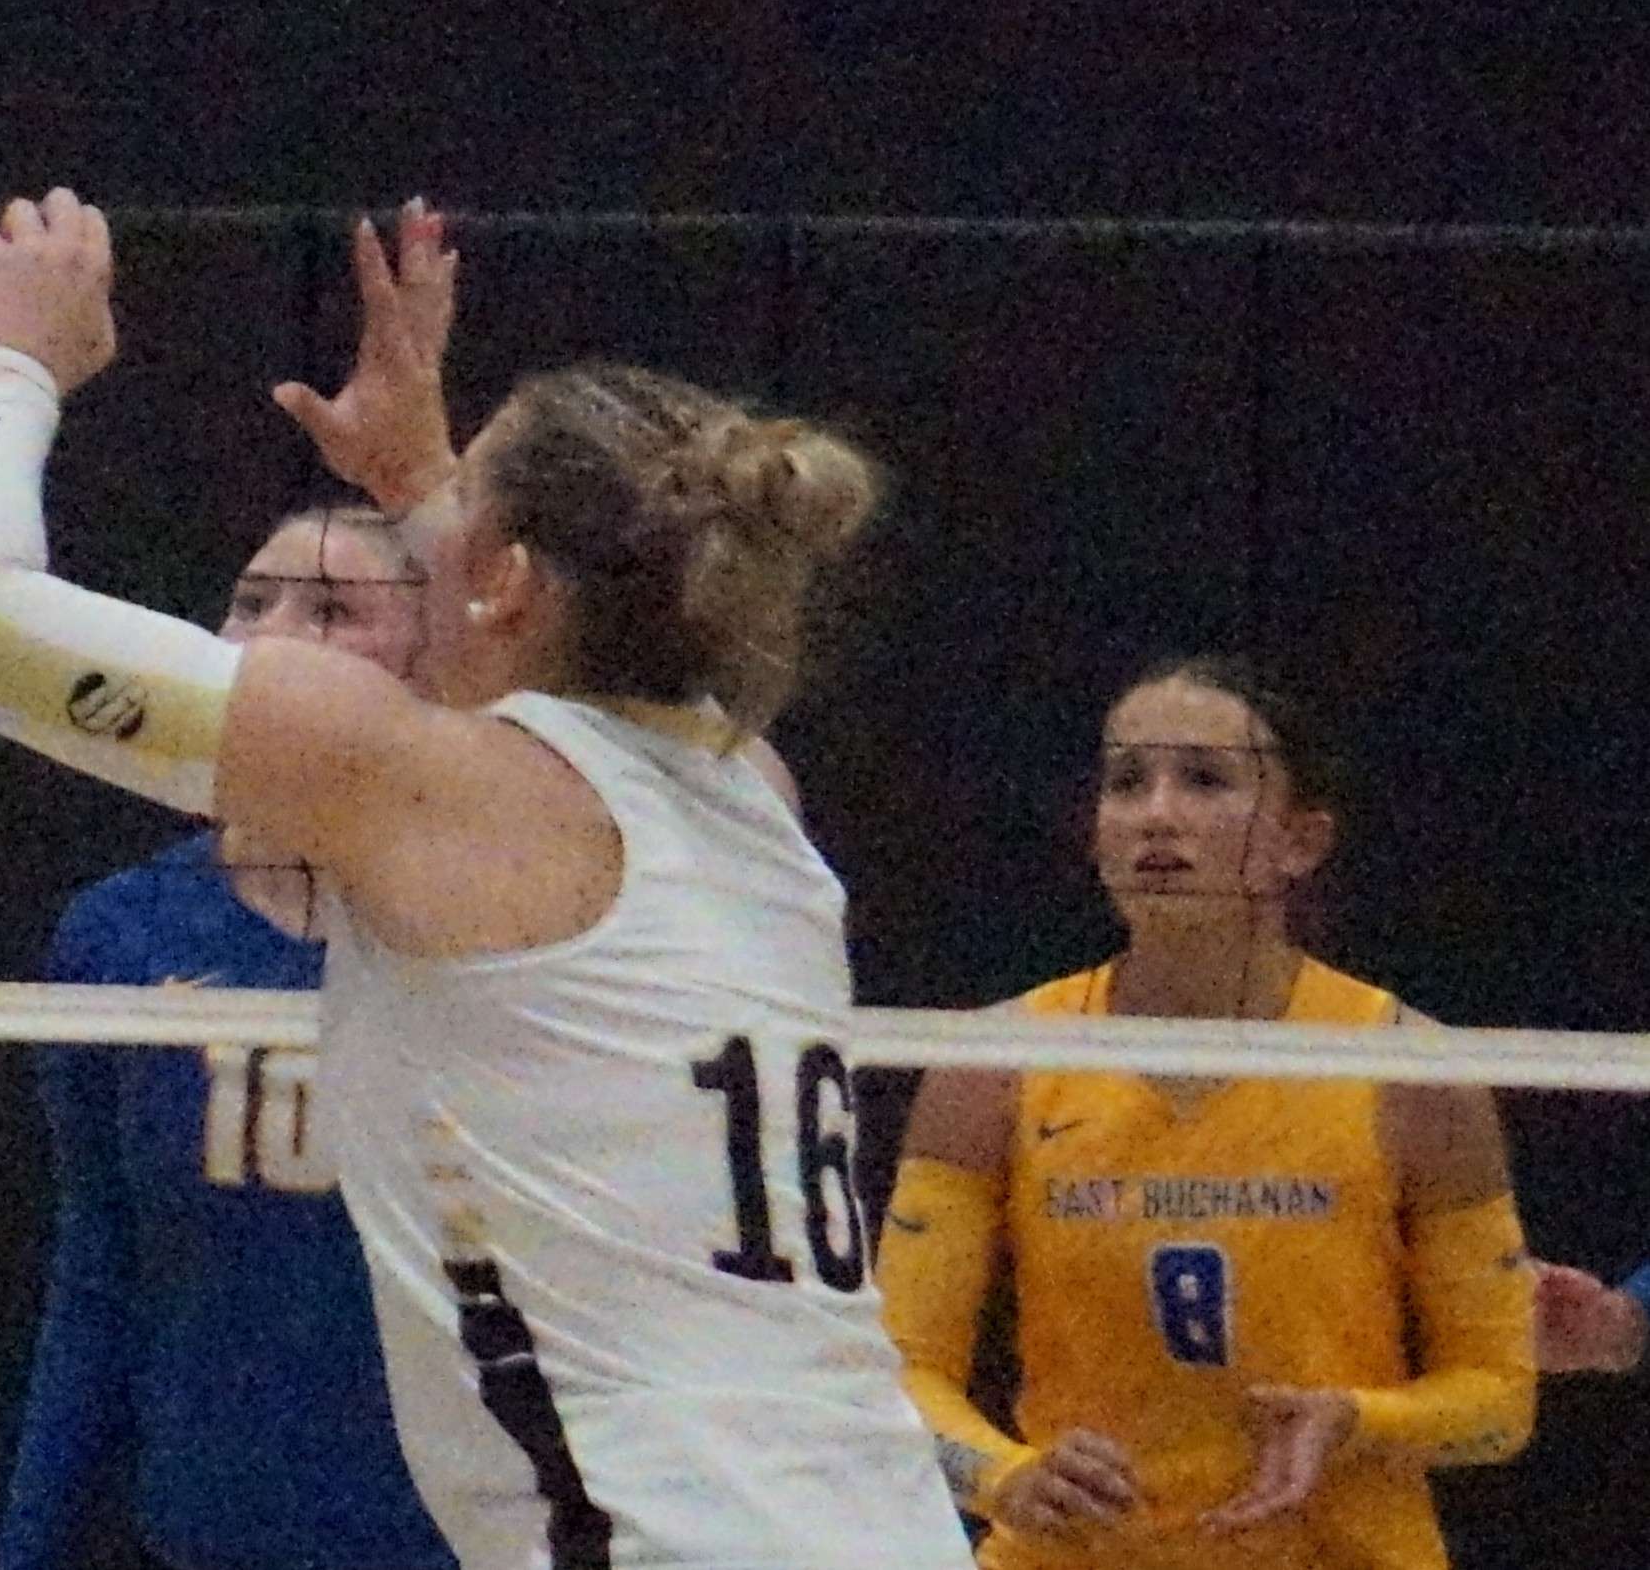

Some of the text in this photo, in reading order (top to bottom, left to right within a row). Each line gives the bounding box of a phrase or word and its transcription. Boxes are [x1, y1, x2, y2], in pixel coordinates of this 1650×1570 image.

[690, 1035, 865, 1293] 16
[1045, 1177, 1336, 1221] EAST BUCHANAN
[1148, 1244, 1230, 1368] 8
